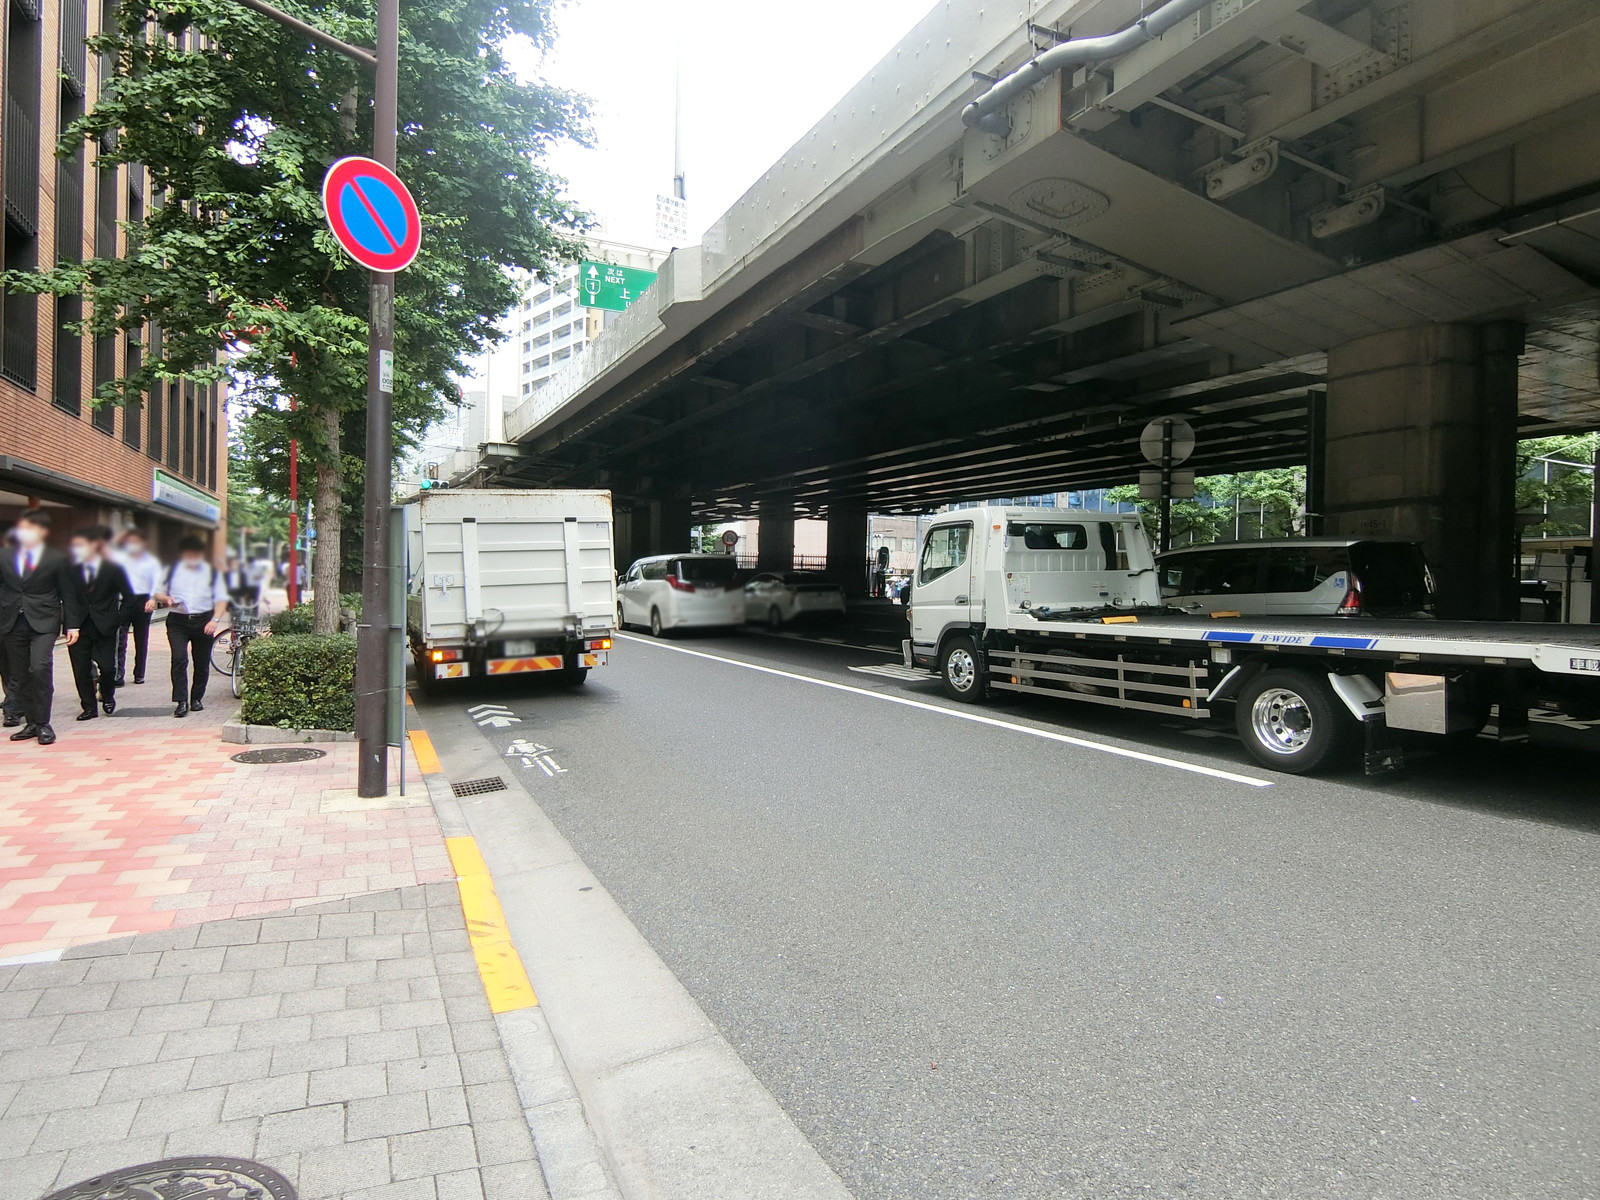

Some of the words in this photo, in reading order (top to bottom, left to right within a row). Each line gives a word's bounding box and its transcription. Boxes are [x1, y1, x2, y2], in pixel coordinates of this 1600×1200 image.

[607, 267, 624, 276] 次は
[605, 275, 626, 285] NEXT
[591, 281, 595, 291] 1
[1260, 634, 1305, 644] B-WIDE
